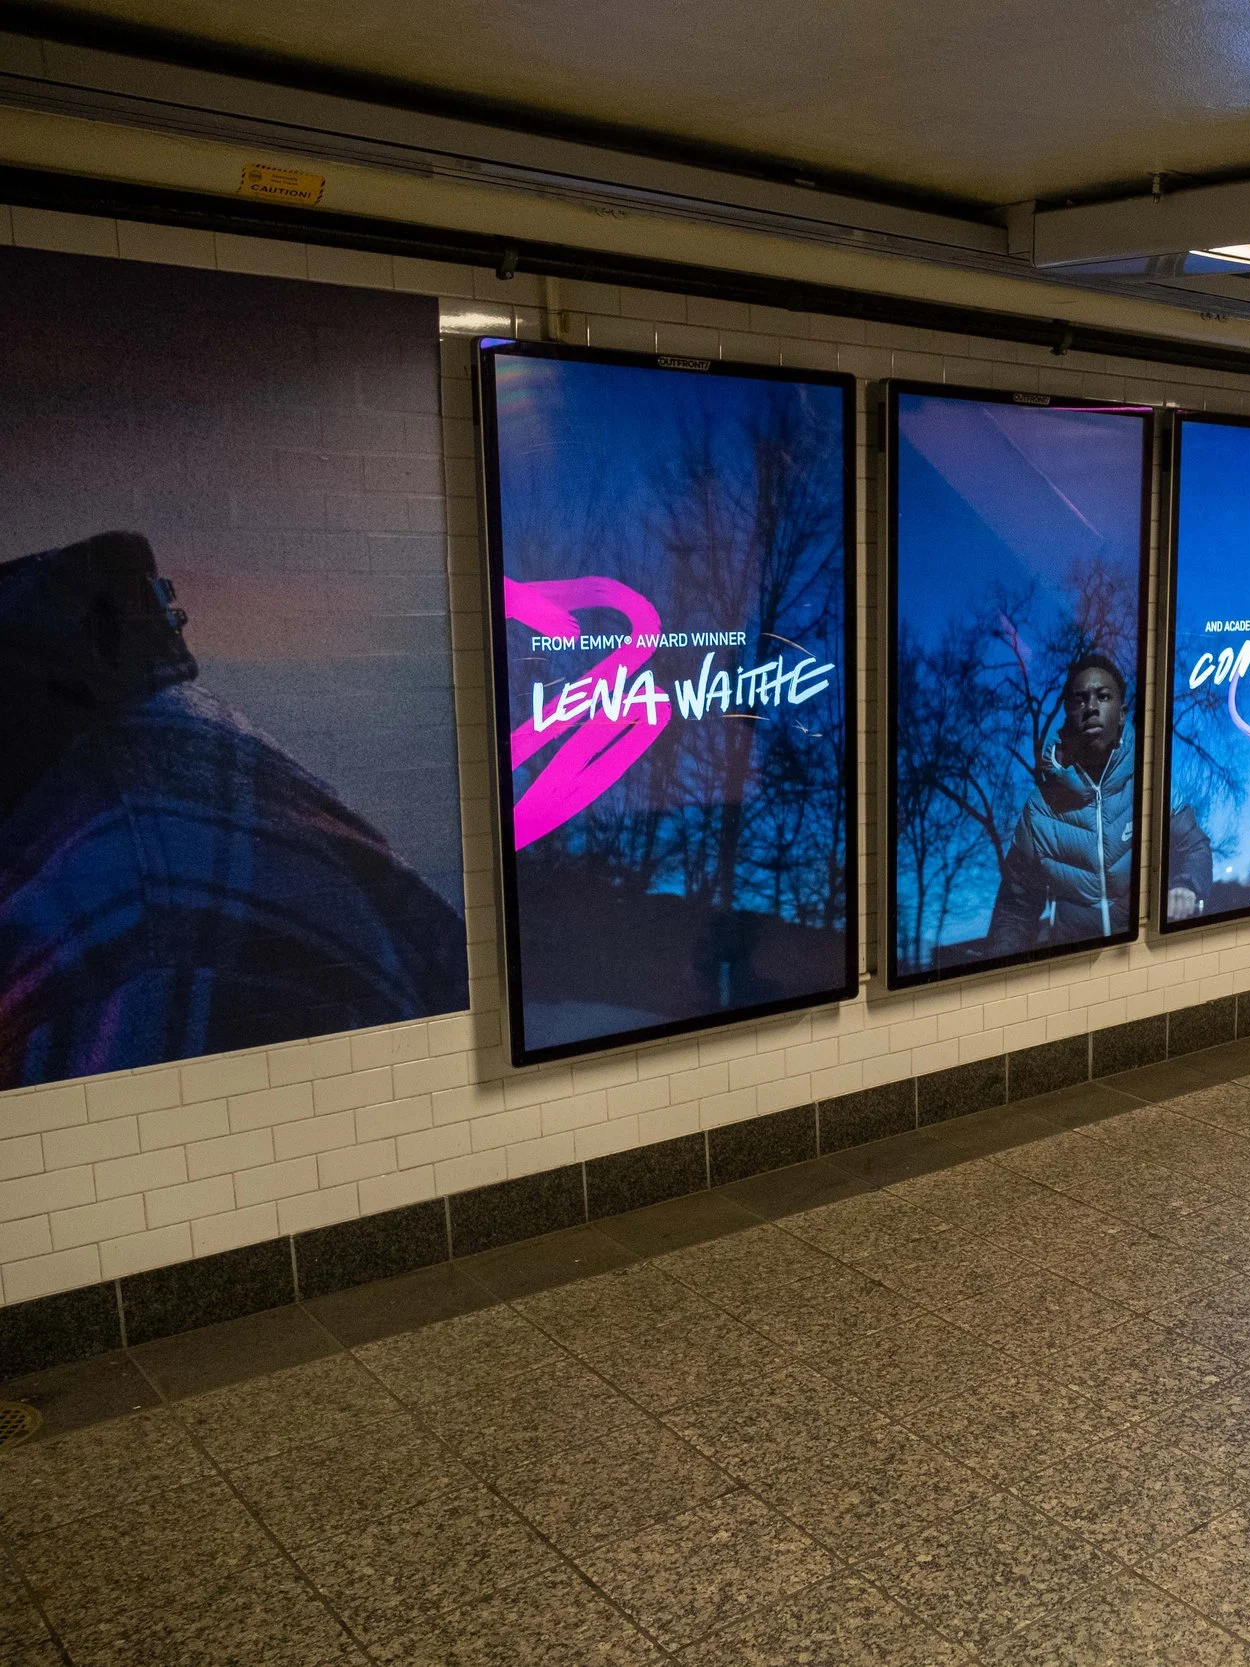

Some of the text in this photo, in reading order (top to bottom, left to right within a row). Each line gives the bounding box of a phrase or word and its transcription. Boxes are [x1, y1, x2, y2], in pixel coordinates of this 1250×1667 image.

[251, 184, 312, 198] CAUTION!
[1205, 621, 1222, 632] AND
[532, 636, 575, 651] FROM
[636, 633, 688, 648] AWARD
[692, 632, 747, 646] WINNER
[532, 663, 670, 732] LENA
